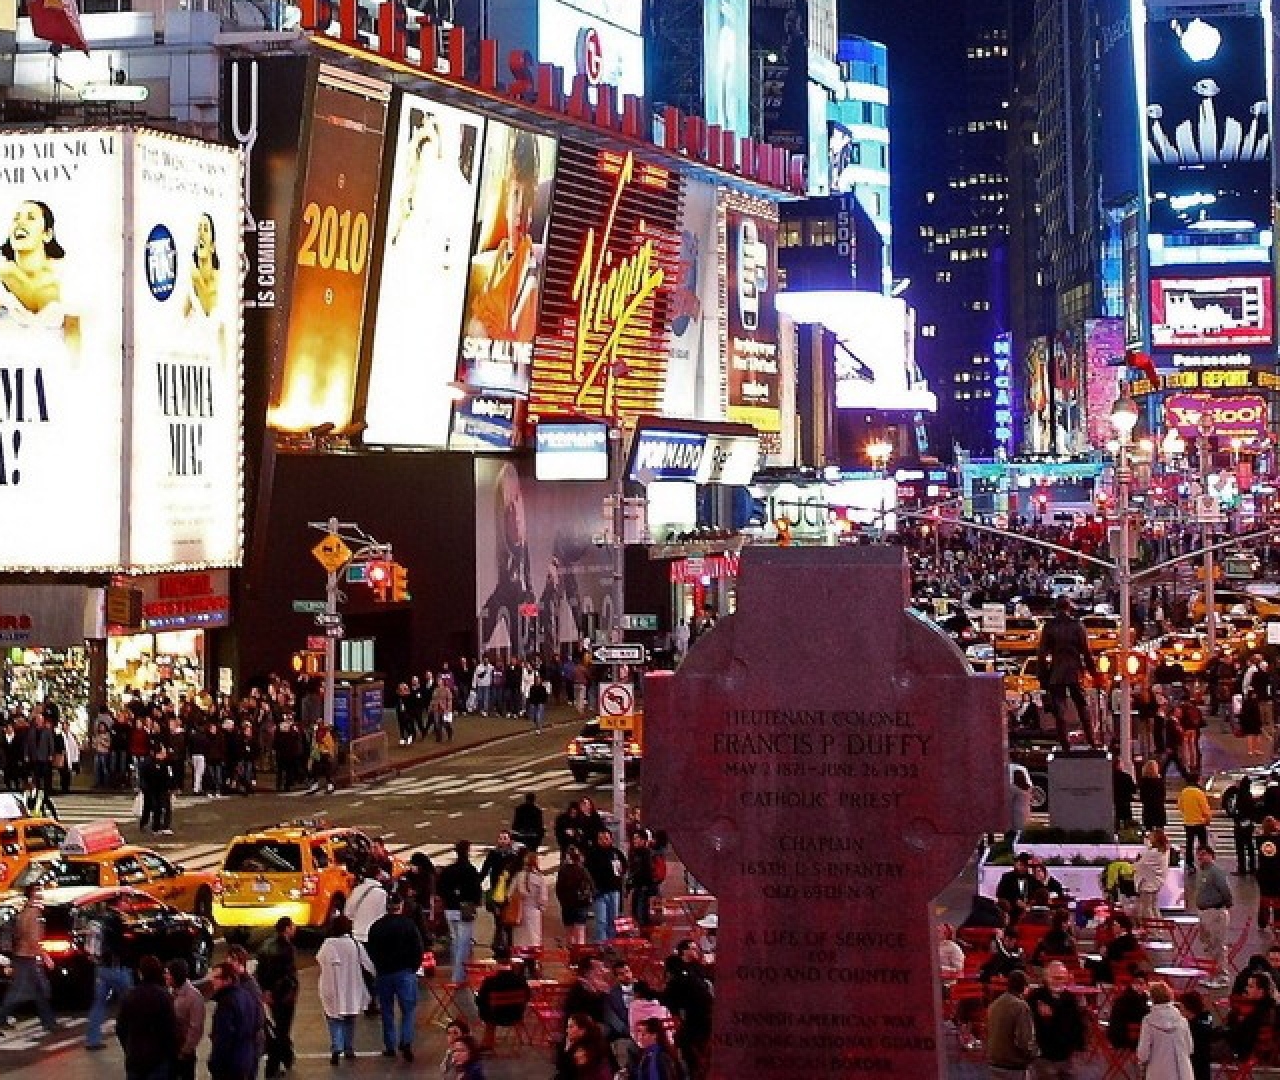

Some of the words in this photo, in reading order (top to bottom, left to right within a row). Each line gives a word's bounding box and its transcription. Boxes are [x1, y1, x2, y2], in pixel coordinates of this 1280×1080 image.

[296, 201, 369, 275] 2010
[257, 219, 276, 277] COMING
[156, 363, 215, 418] MAMMA
[168, 423, 204, 476] MIA!
[725, 710, 826, 726] LIEUTENANT
[832, 711, 914, 727] COLONEL
[712, 733, 814, 756] FRANCIS
[847, 734, 932, 757] DUFFY
[725, 763, 756, 777] MAY
[740, 791, 826, 808] CATHOLIC
[839, 791, 905, 809] PRIEST
[778, 834, 865, 852] CHAPLAIN
[763, 933, 799, 947] LIFE
[835, 932, 907, 949] SERVICE
[784, 968, 821, 983] AND
[827, 967, 912, 984] COUNTRY
